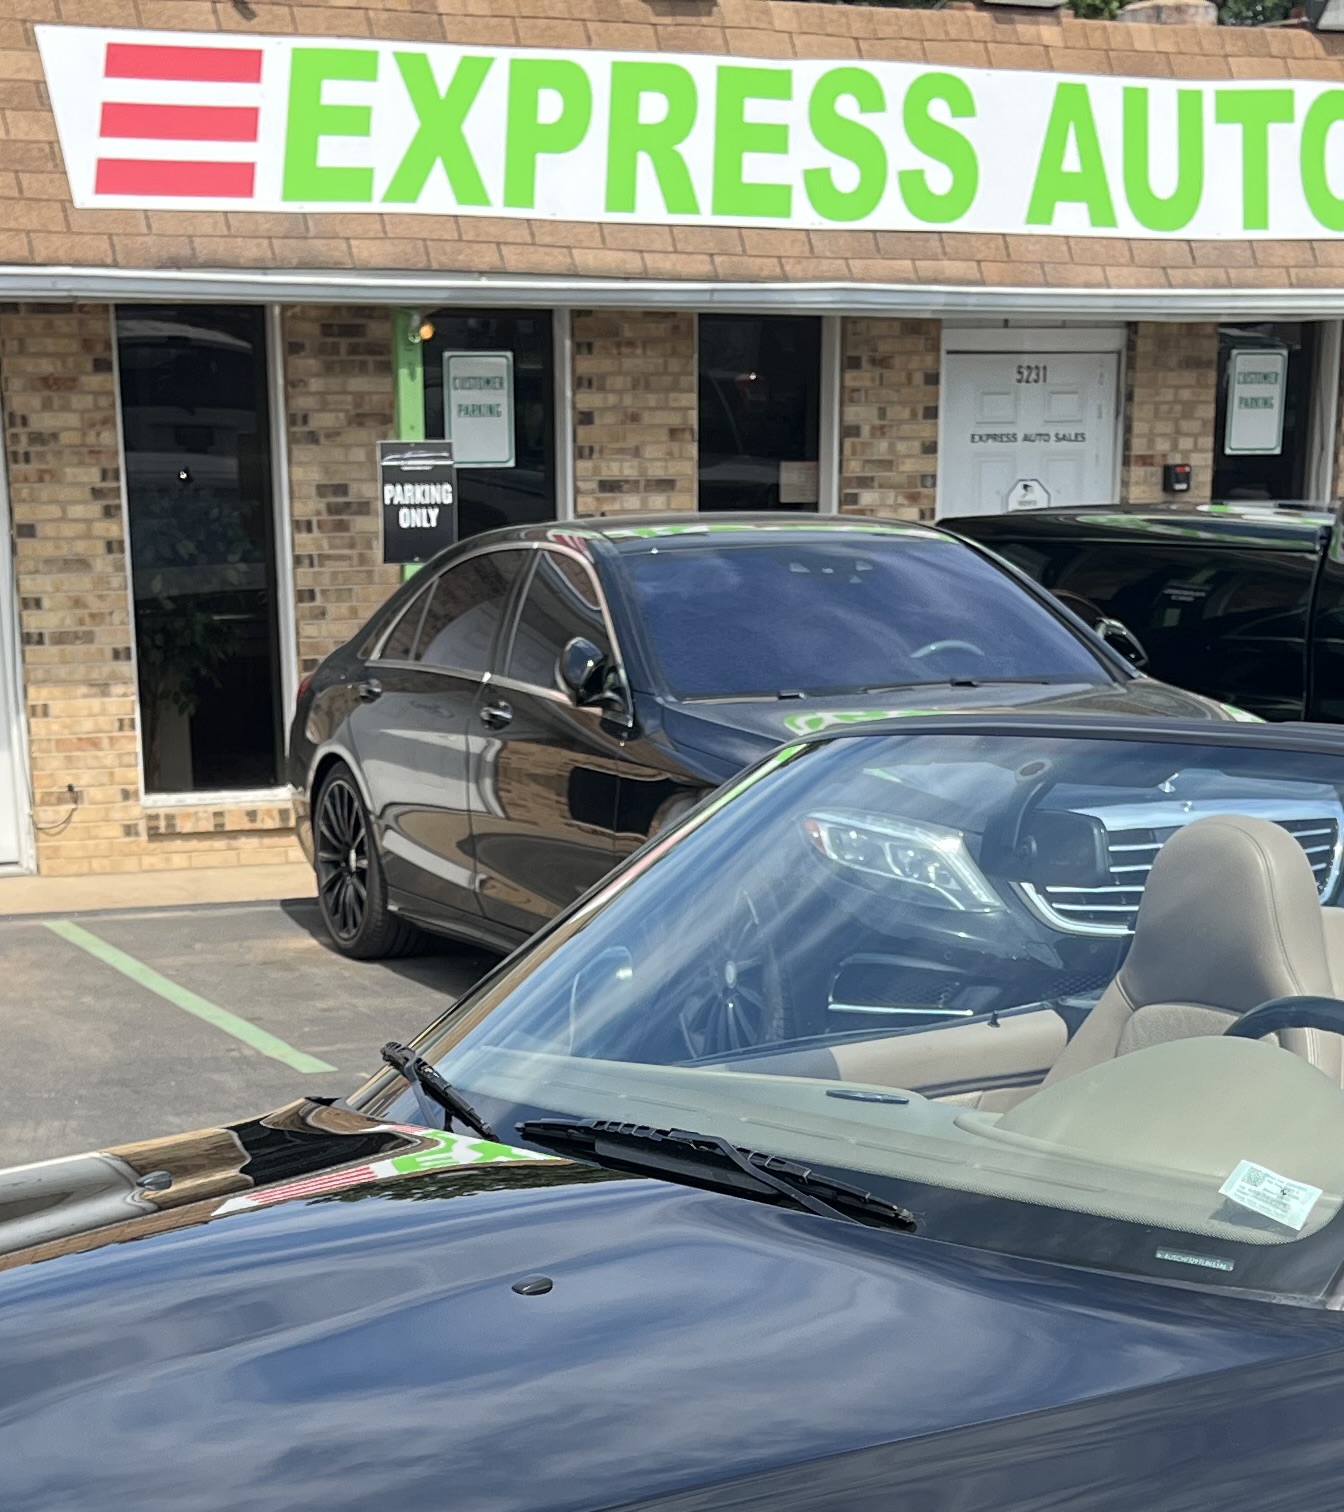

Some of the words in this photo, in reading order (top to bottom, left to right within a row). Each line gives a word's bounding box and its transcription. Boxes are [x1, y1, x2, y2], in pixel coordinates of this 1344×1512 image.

[282, 47, 979, 224] EXPRESS
[1016, 365, 1047, 384] 5231
[970, 433, 1018, 443] EXPRESS
[1022, 433, 1051, 443] AUTO
[1054, 432, 1086, 443] SALES
[384, 483, 453, 505] PARKING
[398, 507, 440, 529] ONLY
